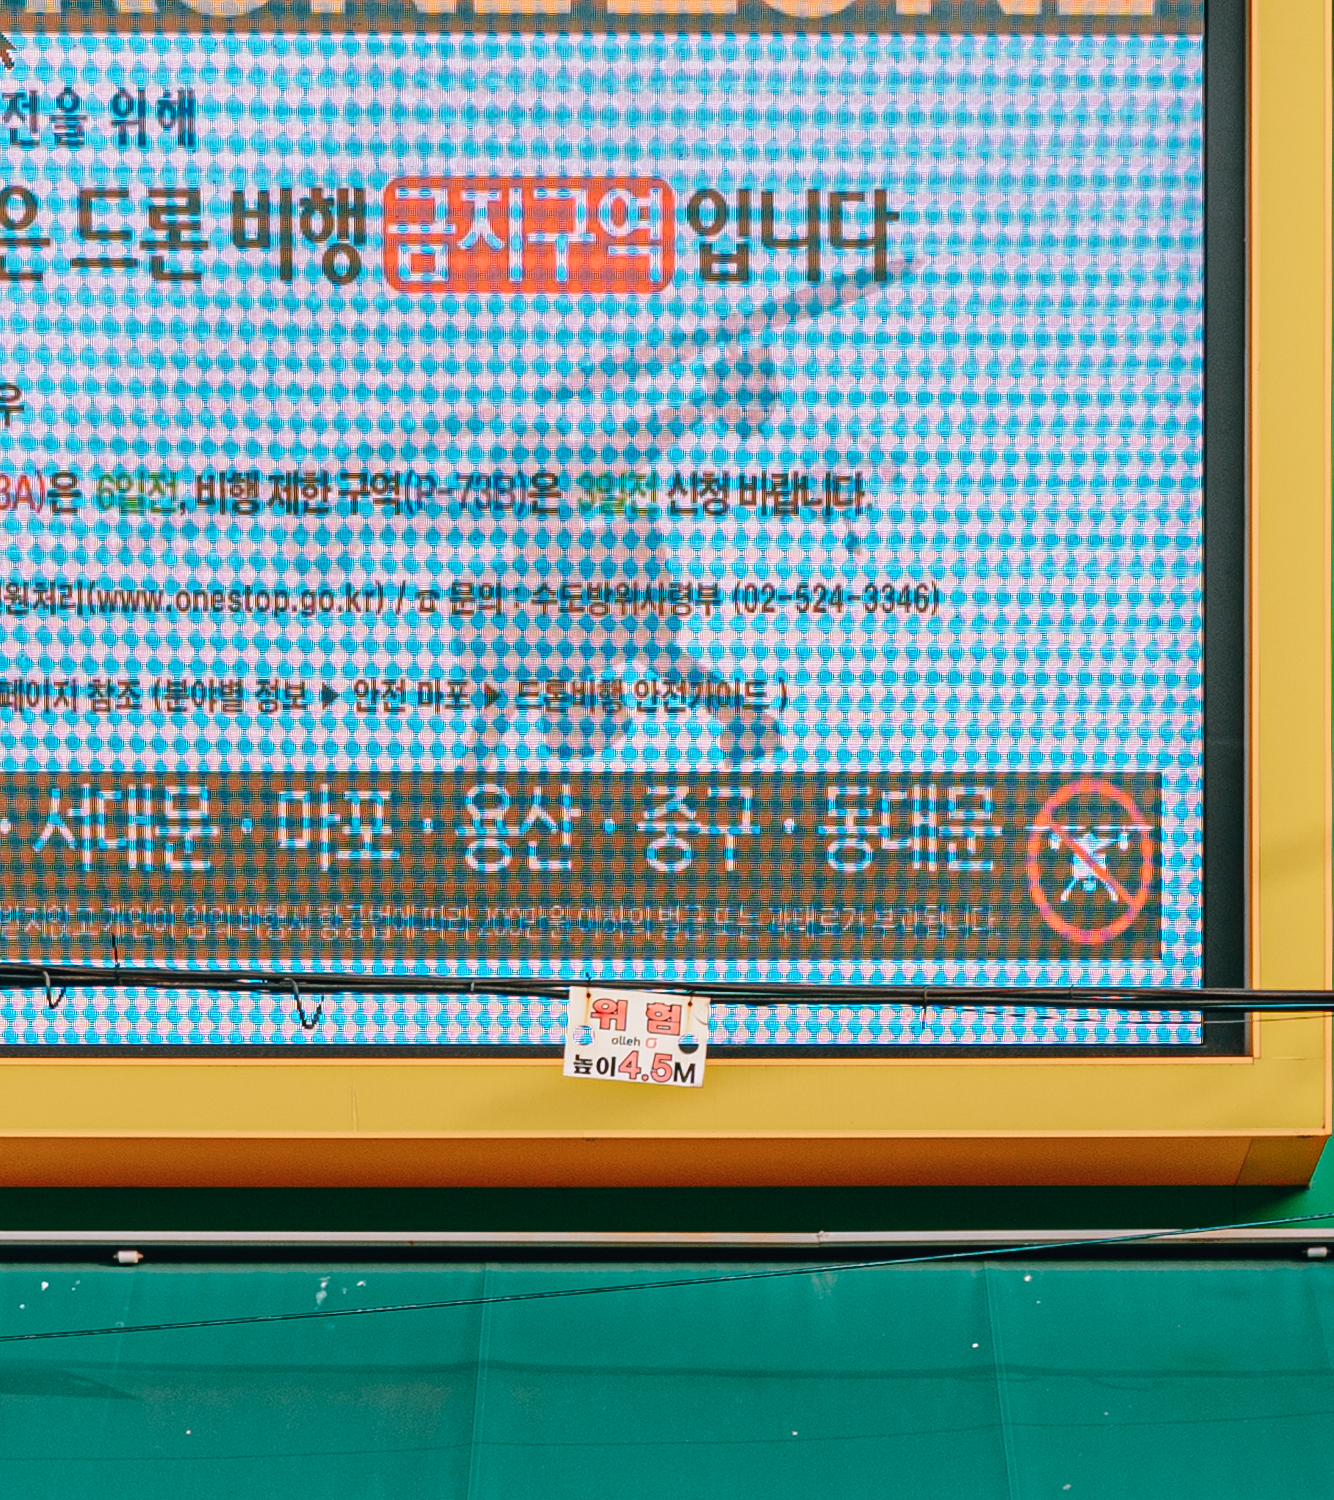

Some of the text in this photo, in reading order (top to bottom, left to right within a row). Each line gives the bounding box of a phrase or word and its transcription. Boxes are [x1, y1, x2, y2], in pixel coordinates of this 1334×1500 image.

[110, 88, 198, 149] 위해
[69, 186, 209, 285] 드론
[231, 186, 367, 286] 비행
[386, 186, 667, 285] 금지구역
[686, 186, 901, 285] 입니다
[30, 784, 220, 873] 서대문
[278, 784, 401, 873] 마포
[454, 784, 582, 873] 용산
[636, 784, 761, 873] 중구
[816, 784, 1003, 873] 동대문
[611, 1036, 641, 1047] olleh
